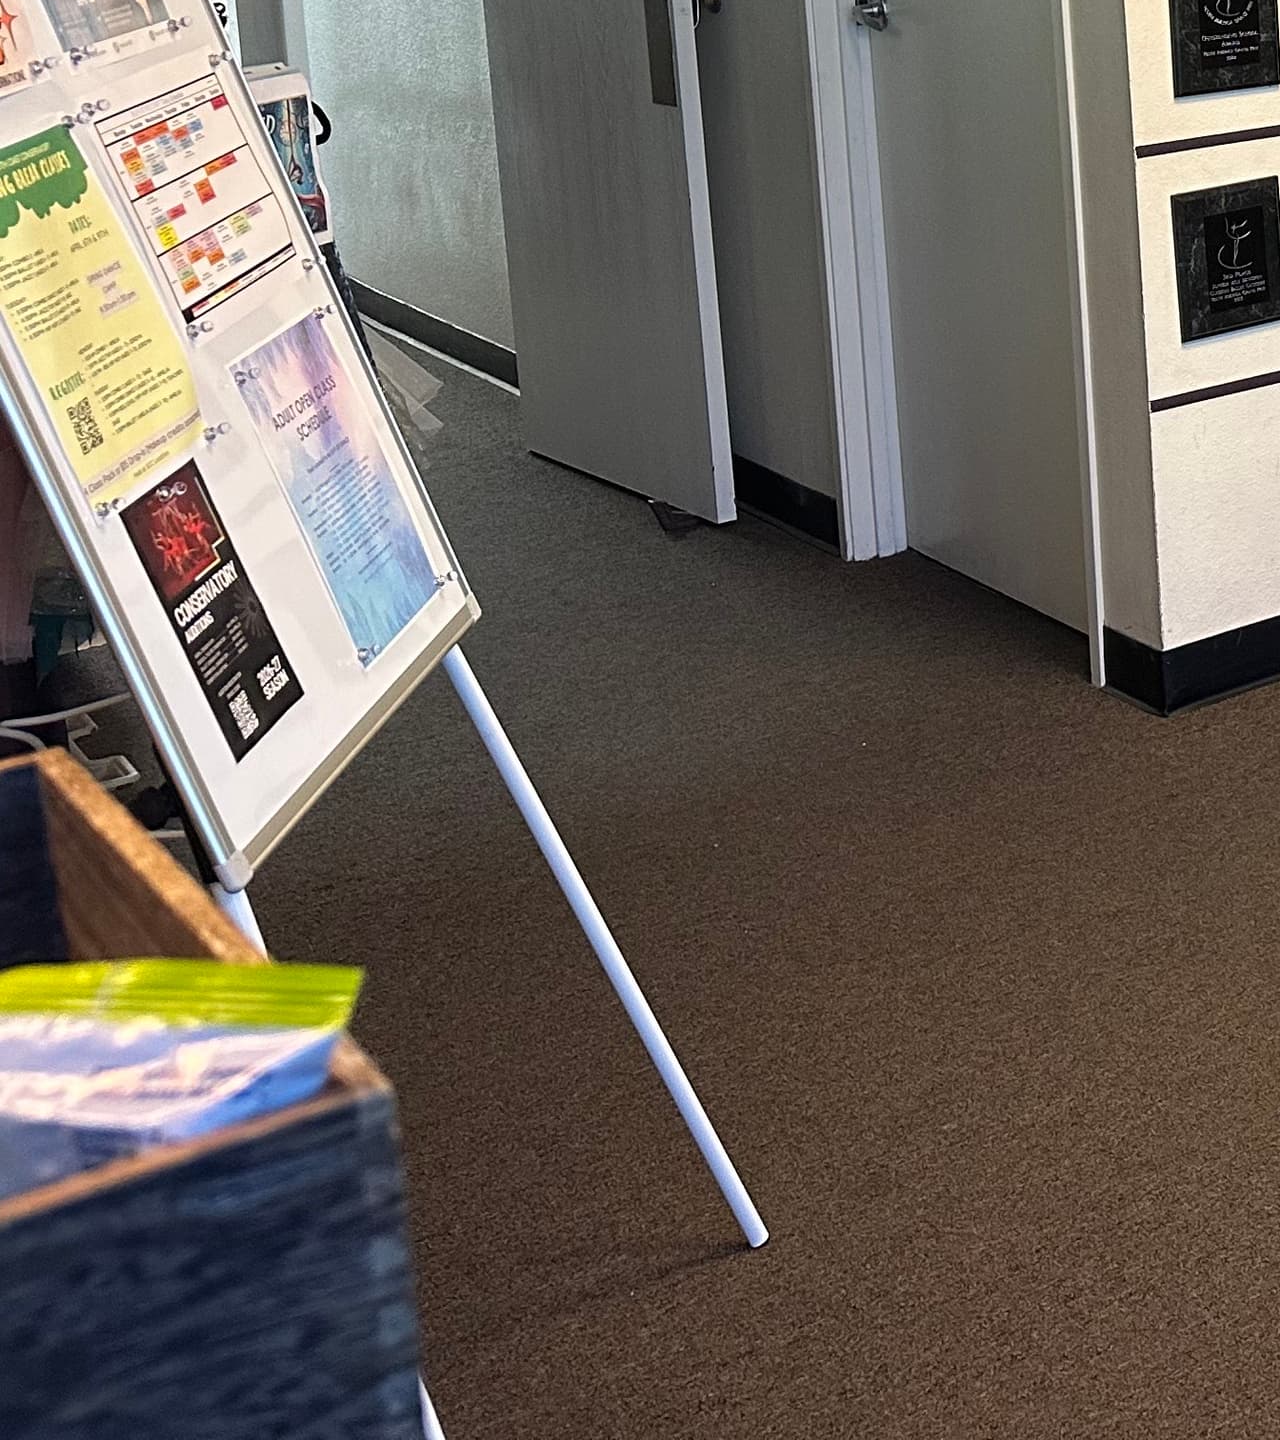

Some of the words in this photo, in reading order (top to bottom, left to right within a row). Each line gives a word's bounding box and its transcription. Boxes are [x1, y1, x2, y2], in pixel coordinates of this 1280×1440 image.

[271, 404, 297, 432] ADULT
[295, 391, 316, 416] OPEN
[313, 375, 337, 401] CLASS
[296, 406, 333, 442] SCHEDULE
[173, 559, 239, 628] CONSERVATORY
[262, 668, 290, 702] SEASON
